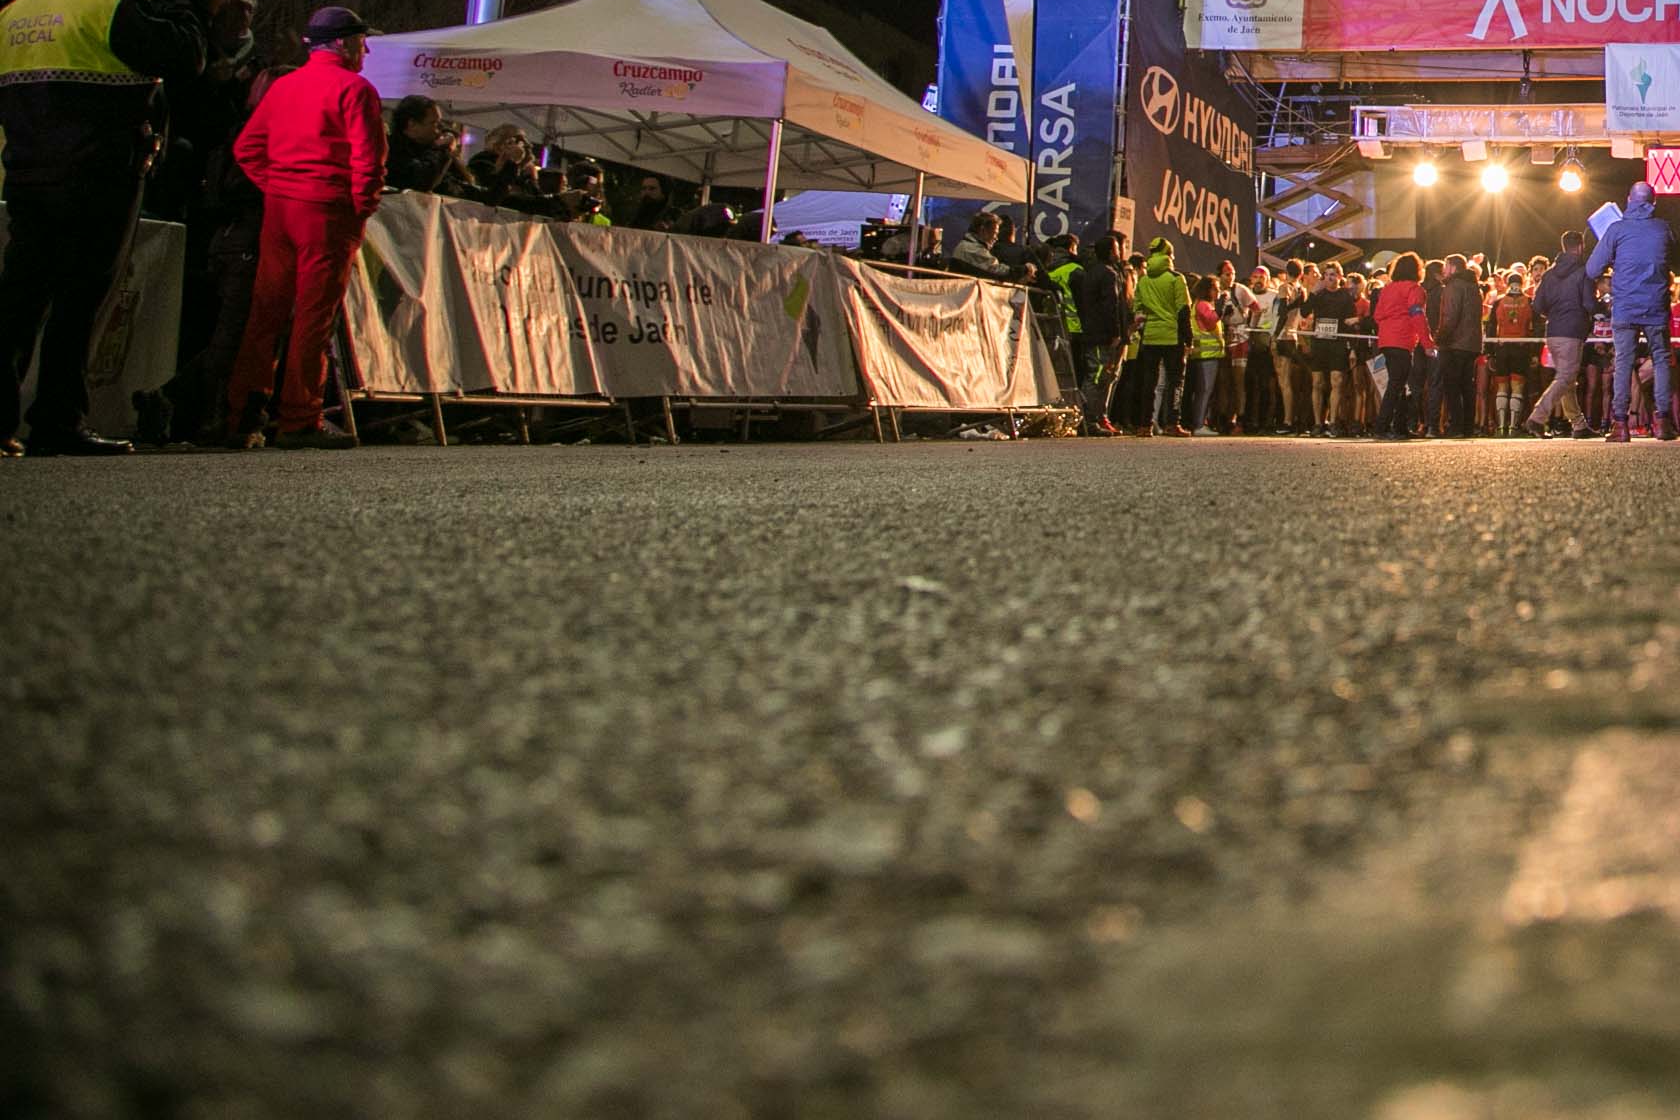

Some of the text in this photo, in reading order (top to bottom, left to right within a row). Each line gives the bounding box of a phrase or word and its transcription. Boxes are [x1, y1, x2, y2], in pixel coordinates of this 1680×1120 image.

[1227, 25, 1238, 34] de
[1233, 13, 1293, 24] Ayuntamiento
[413, 52, 503, 71] Cruzcampo
[614, 60, 703, 83] Cruzcampo
[1183, 92, 1253, 178] HYUNDAI
[1034, 82, 1077, 243] CARSA
[1154, 169, 1240, 255] JACARSA
